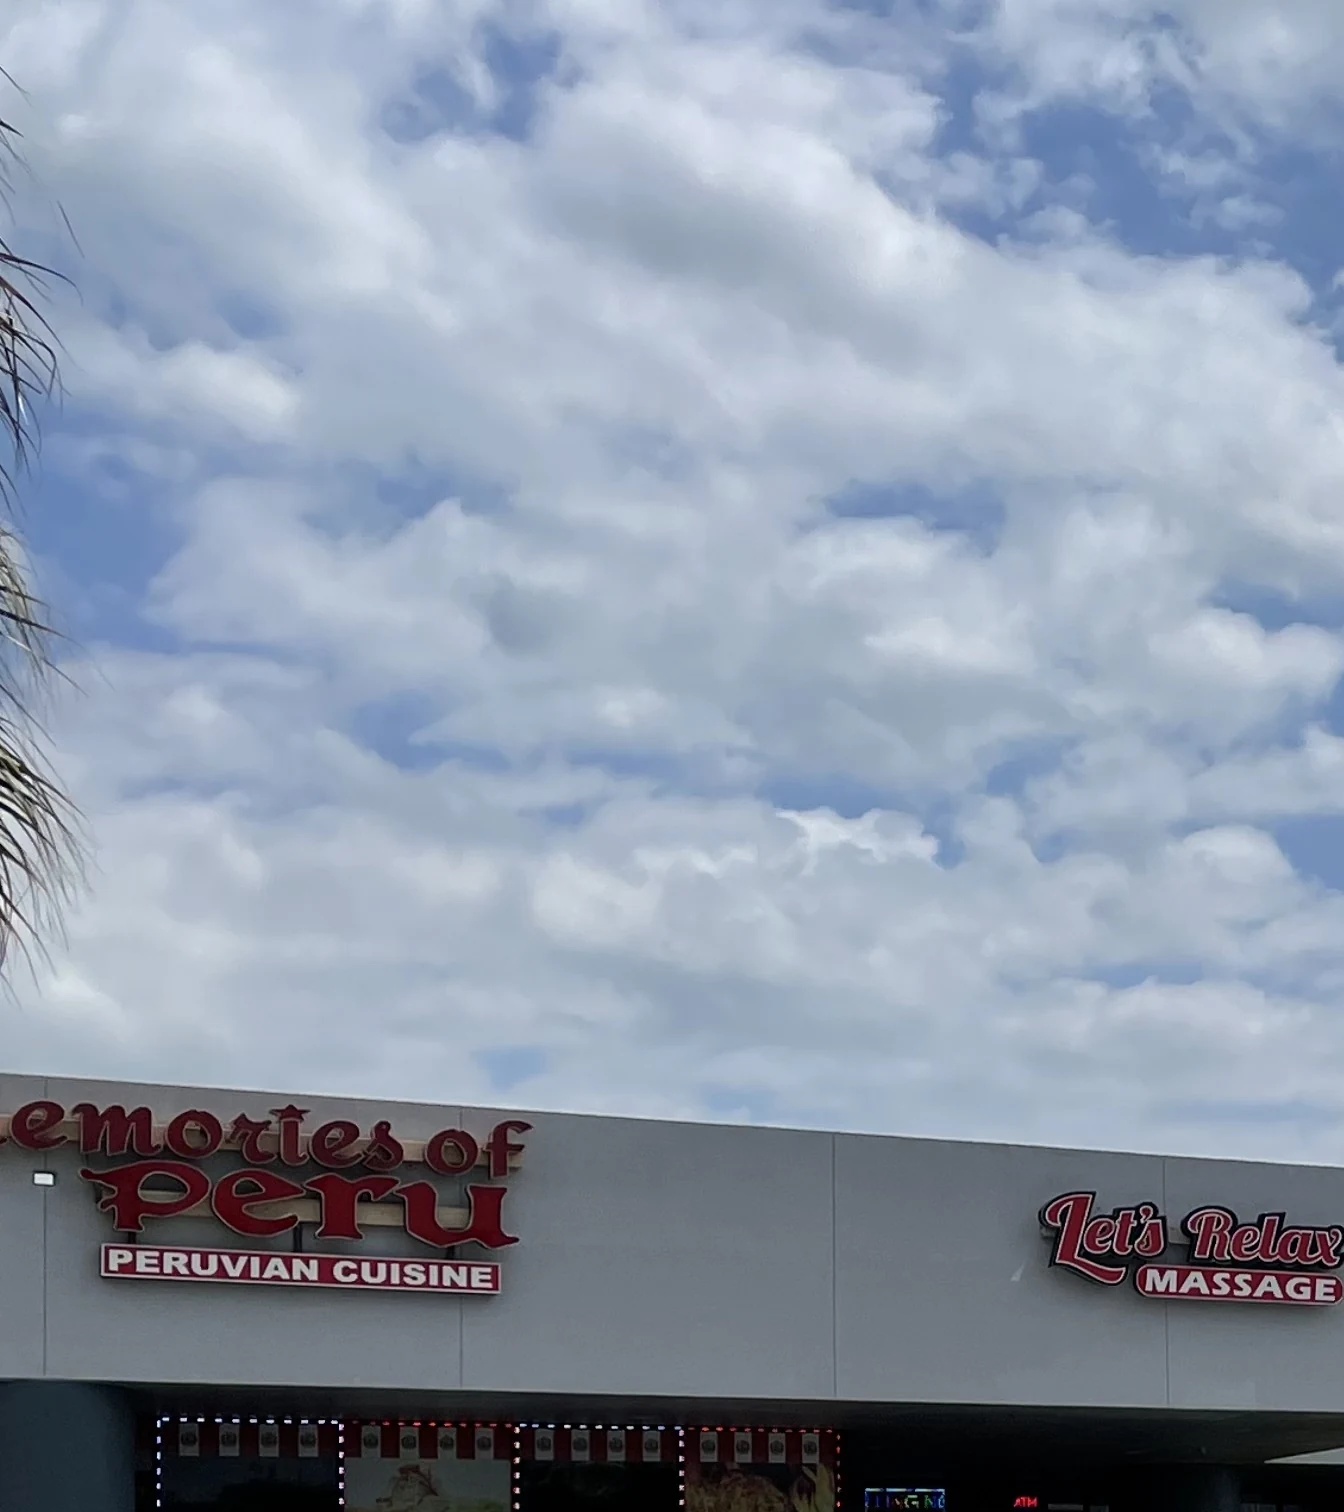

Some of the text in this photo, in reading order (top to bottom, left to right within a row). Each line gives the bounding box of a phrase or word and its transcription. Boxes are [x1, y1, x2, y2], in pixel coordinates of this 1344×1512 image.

[0, 1100, 533, 1179] emories of
[1044, 1192, 1344, 1285] Let's Relax
[107, 1249, 494, 1289] PERUVIAN CUISINE
[1143, 1271, 1338, 1302] MASSAGE
[1013, 1497, 1038, 1508] ATM
